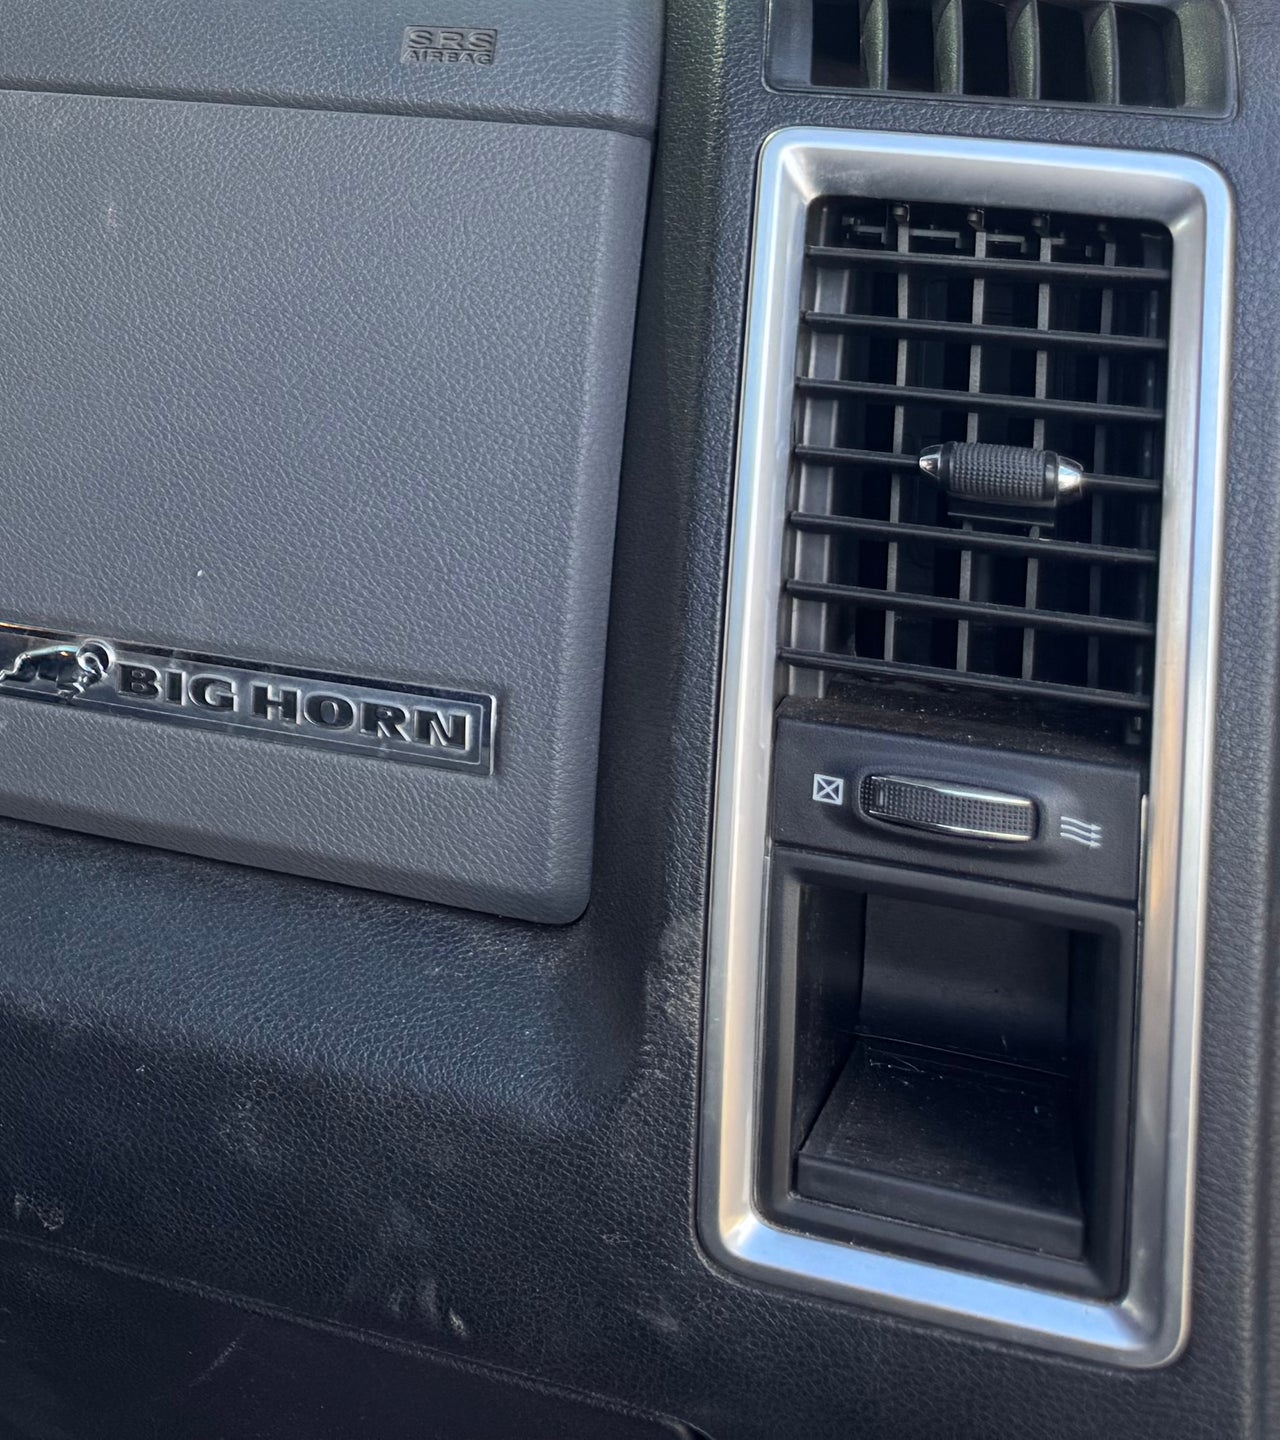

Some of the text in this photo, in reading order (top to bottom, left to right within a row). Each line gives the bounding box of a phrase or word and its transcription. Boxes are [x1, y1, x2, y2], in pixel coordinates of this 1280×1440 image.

[407, 29, 494, 52] SRS
[401, 49, 493, 66] AIRBAG
[116, 661, 472, 752] BIG HORN
